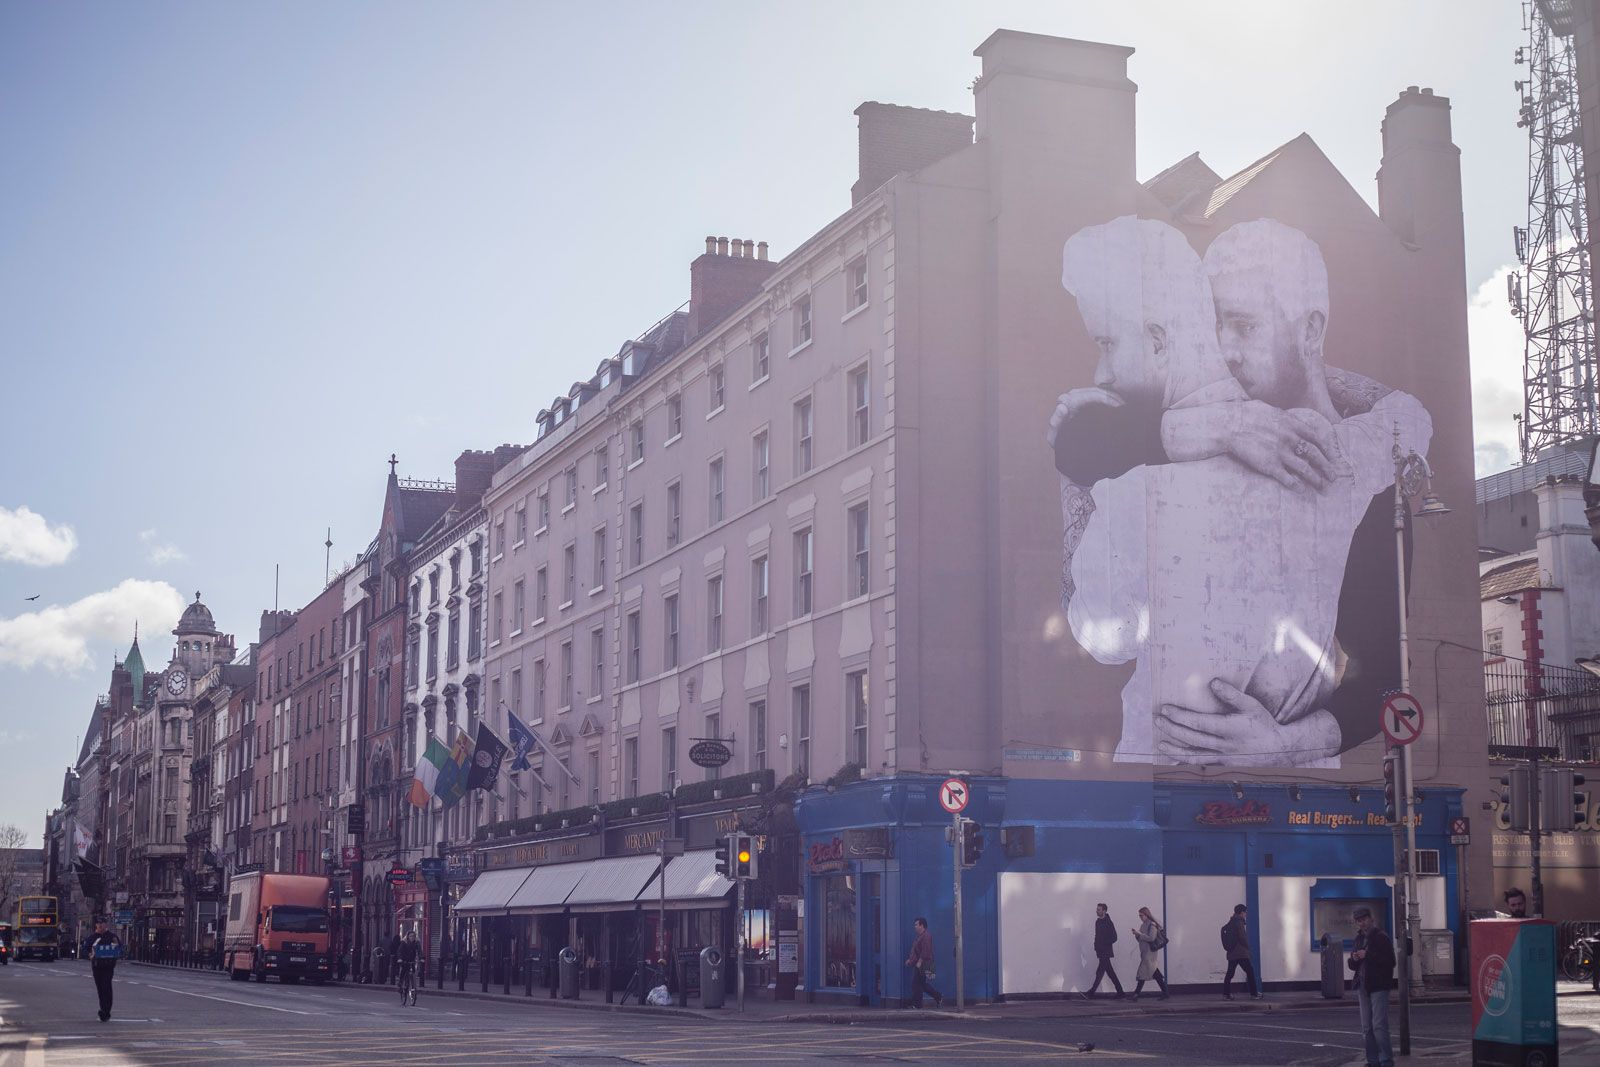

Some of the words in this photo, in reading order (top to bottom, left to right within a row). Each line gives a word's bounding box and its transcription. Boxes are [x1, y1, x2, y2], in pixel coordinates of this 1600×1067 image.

[691, 752, 729, 761] SOLICITORS
[1288, 811, 1311, 825] Real
[1314, 811, 1363, 829] Burgers...
[1367, 812, 1388, 826] Rea
[1553, 835, 1574, 846] CLUB
[1484, 985, 1505, 1000] TOWN
